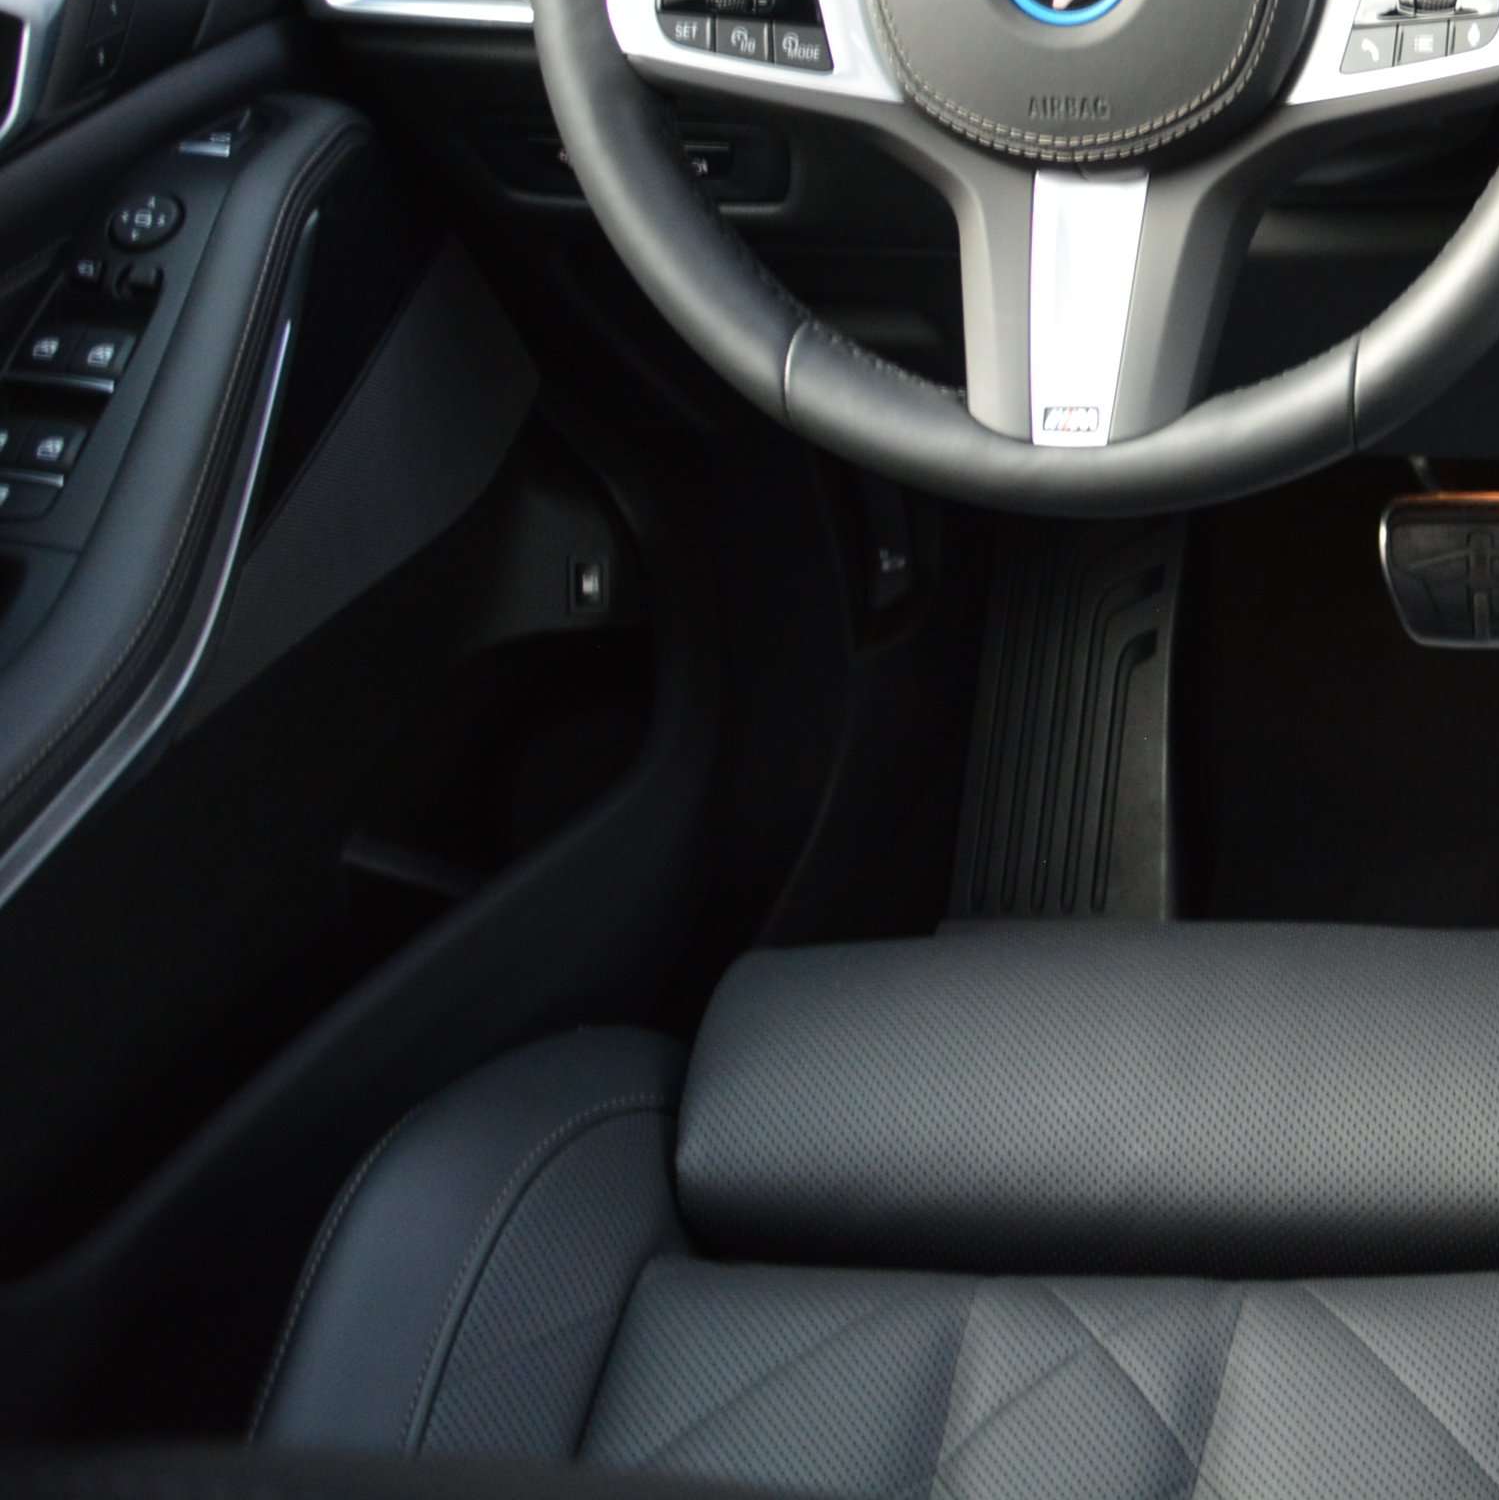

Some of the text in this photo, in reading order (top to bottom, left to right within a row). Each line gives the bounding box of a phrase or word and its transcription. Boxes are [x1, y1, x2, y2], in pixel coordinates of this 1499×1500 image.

[675, 20, 698, 40] SET
[787, 43, 821, 61] MODE
[1027, 94, 1111, 120] AIRBAG
